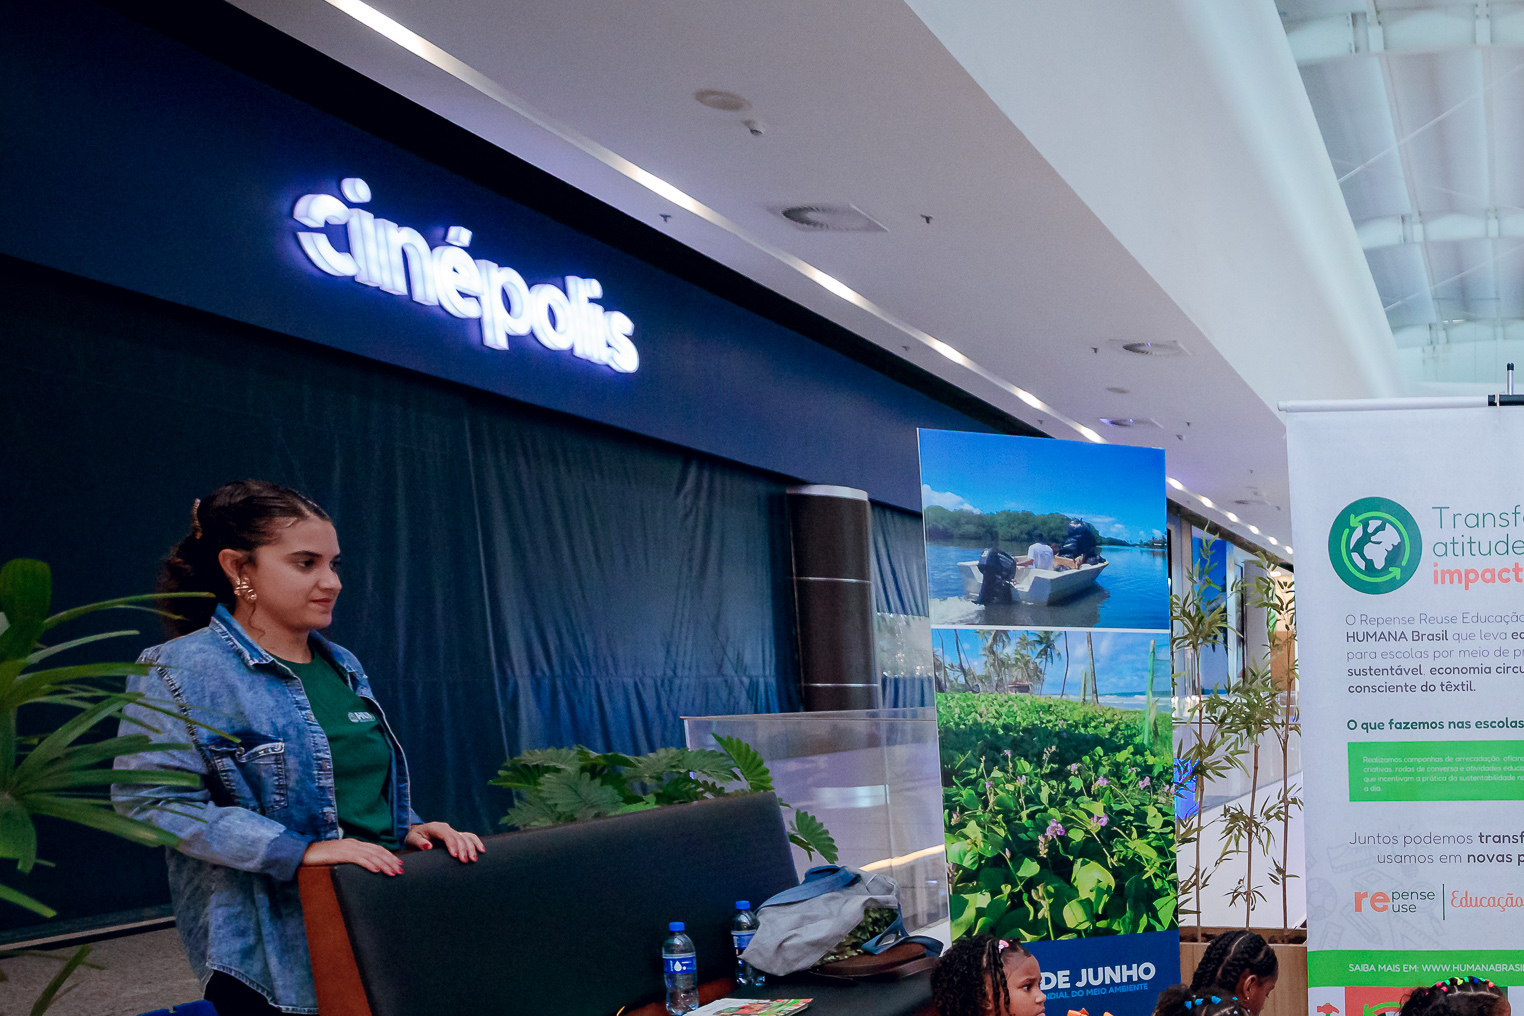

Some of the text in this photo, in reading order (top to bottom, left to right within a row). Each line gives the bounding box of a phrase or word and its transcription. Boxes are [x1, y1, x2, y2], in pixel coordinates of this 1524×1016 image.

[293, 177, 639, 373] cinépolis
[1345, 614, 1356, 626] O
[1360, 614, 1415, 628] Repense
[1419, 613, 1458, 625] Reuse
[1346, 631, 1408, 642] HUMANA
[1411, 630, 1448, 642] Brasil
[1452, 632, 1476, 643] que
[1480, 629, 1507, 641] leva
[1346, 650, 1377, 662] para
[1380, 648, 1430, 660] escolas
[1433, 649, 1454, 661] por
[1458, 646, 1490, 658] meio
[1494, 646, 1510, 658] de
[1347, 664, 1426, 676] sustentável,
[1429, 663, 1492, 675] economia
[1348, 680, 1476, 694] consciente do têxtil.
[1347, 719, 1358, 730] O
[1361, 721, 1385, 733] que
[1388, 718, 1445, 730] fazemos
[1448, 720, 1472, 730] nas
[1362, 756, 1402, 764] Realizamos
[1404, 756, 1444, 764] campanhas
[1466, 764, 1502, 772] atividades
[1364, 776, 1376, 784] que
[1422, 775, 1447, 783] prática
[1448, 774, 1458, 782] da
[1459, 774, 1516, 782] sustentabilidade
[1349, 832, 1399, 845] Juntos
[1403, 832, 1474, 848] podemos
[1377, 854, 1434, 864] usamos
[1439, 854, 1462, 864] em
[1467, 852, 1513, 864] novas
[1391, 904, 1417, 913] use
[1348, 964, 1376, 972] SAIBA
[1378, 964, 1400, 972] MAIS
[1402, 964, 1420, 972] EM:
[1040, 962, 1156, 990] DE JUNHO
[1046, 983, 1148, 1000] NDIAL DO MEIO AMBIENTE
